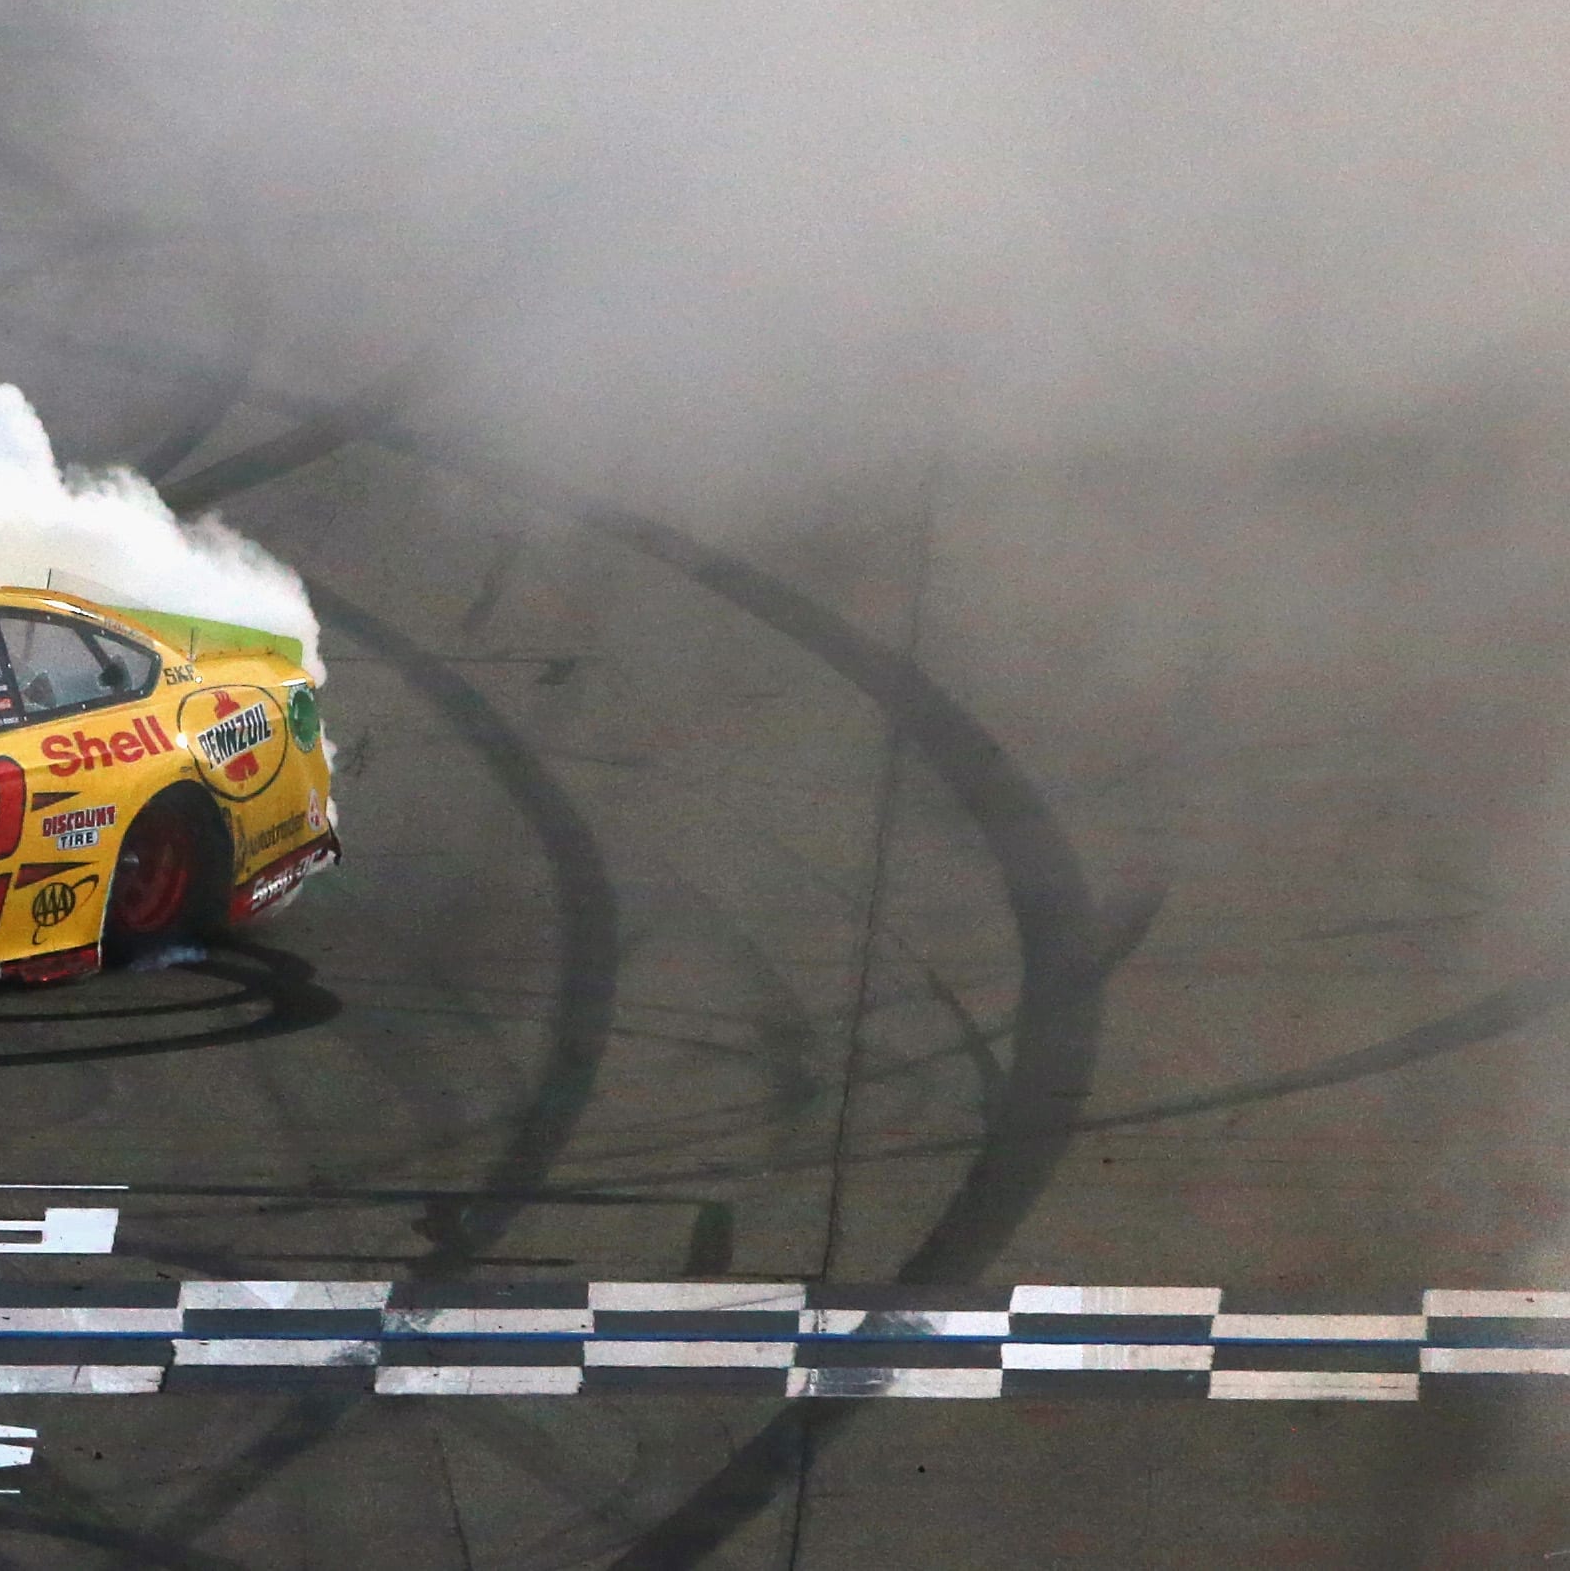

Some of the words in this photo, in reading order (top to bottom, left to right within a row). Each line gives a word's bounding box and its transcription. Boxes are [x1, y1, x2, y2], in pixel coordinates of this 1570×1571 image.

[41, 715, 174, 777] Shell
[197, 702, 273, 770] PENNZOIL
[42, 805, 117, 837] DISCOUNT
[60, 832, 95, 848] TIRE
[33, 884, 75, 924] AAA
